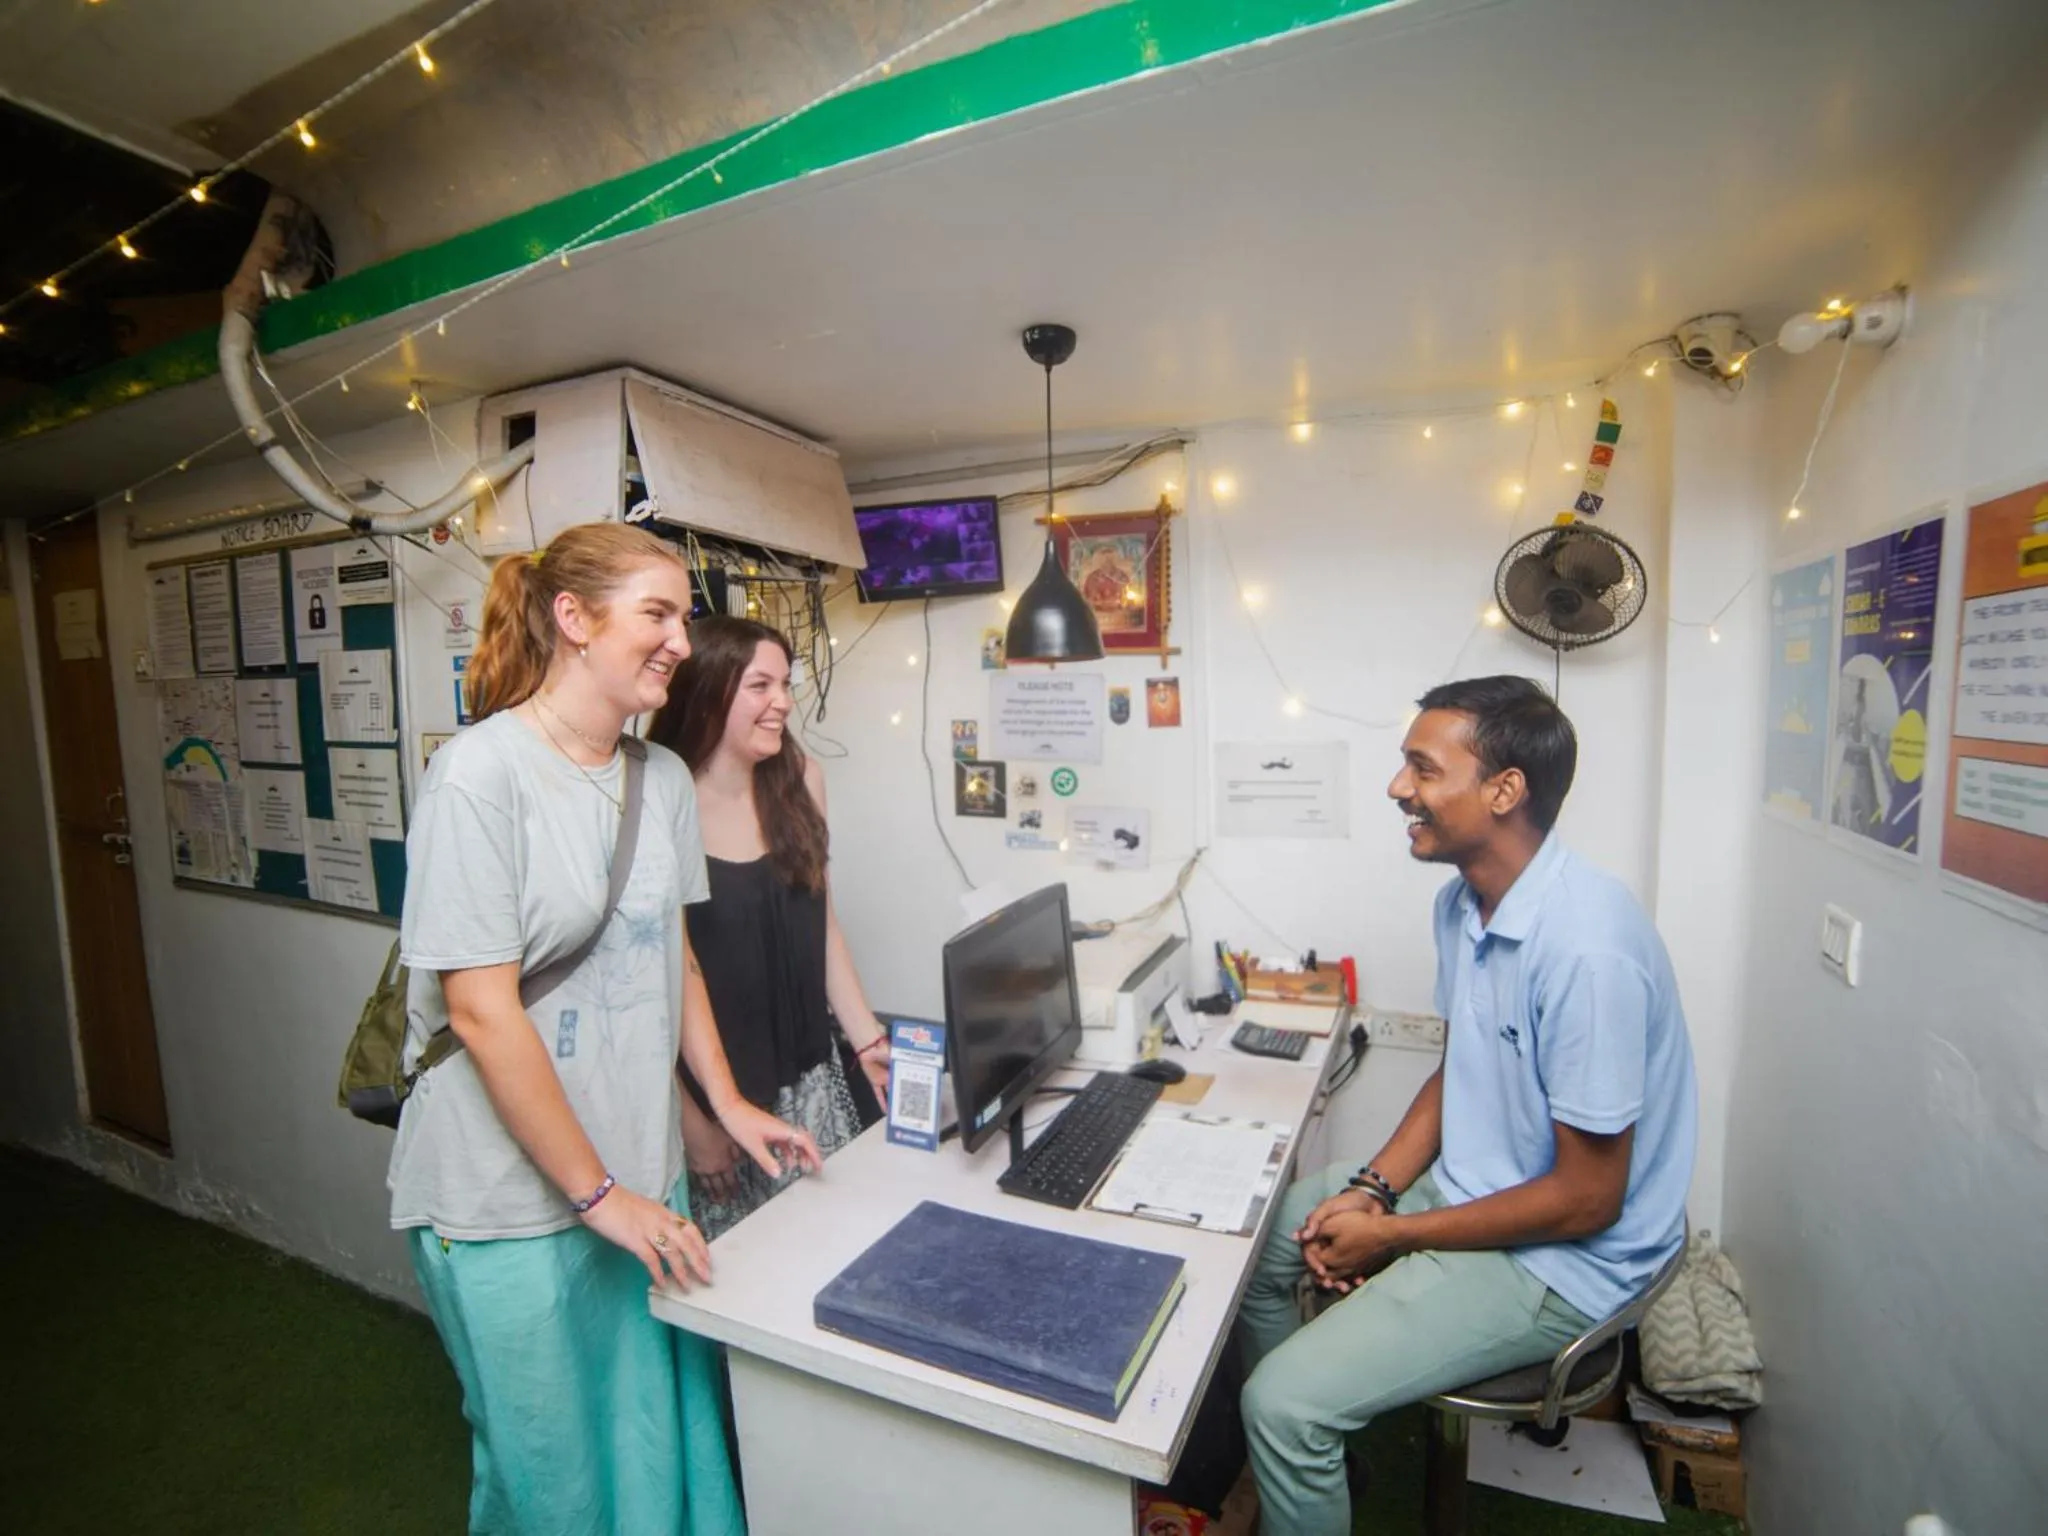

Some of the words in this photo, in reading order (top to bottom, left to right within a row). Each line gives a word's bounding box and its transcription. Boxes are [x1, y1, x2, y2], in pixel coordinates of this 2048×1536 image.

[220, 523, 256, 548] NOTICE
[262, 512, 315, 541] BOARD
[1018, 681, 1049, 691] PLEASE
[1051, 681, 1074, 691] NOTE
